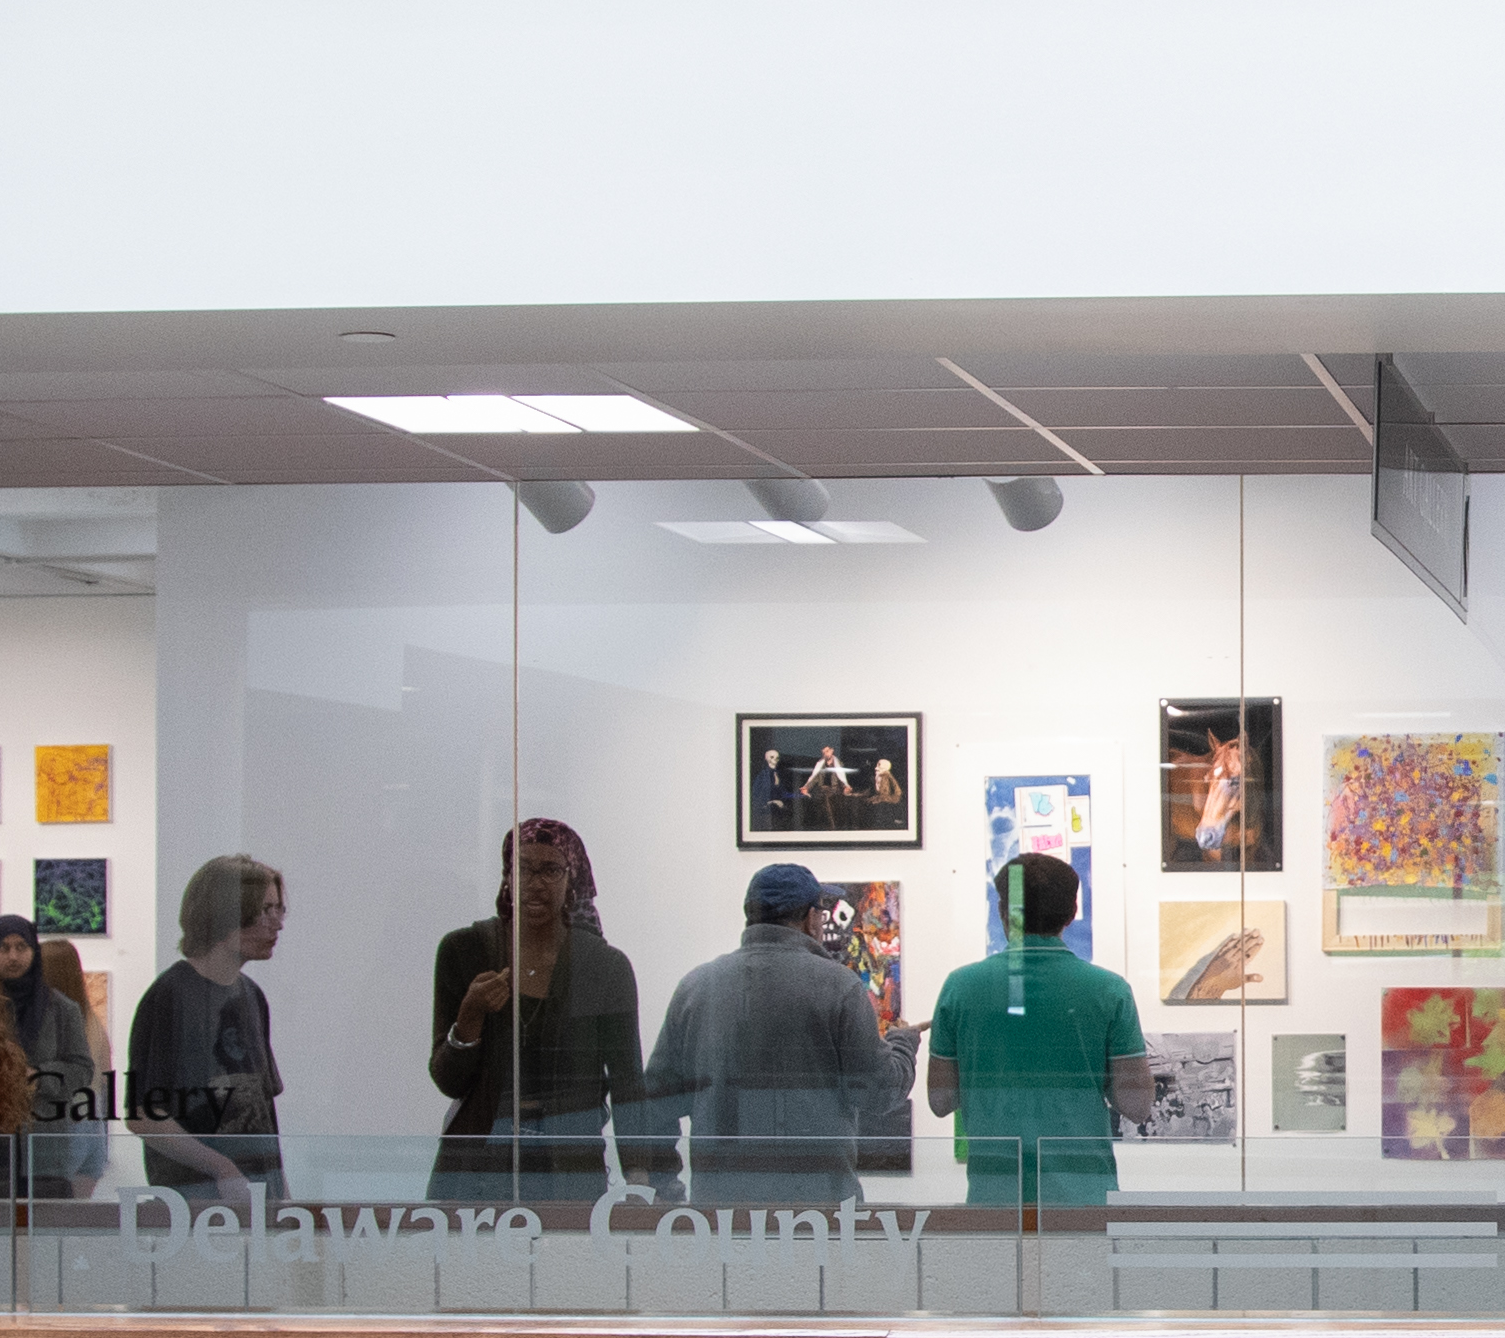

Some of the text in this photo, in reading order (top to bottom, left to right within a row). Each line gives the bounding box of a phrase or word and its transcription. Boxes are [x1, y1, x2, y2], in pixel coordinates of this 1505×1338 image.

[28, 1068, 236, 1134] Gallery
[116, 1181, 544, 1264] Delaware
[590, 1181, 932, 1268] County
